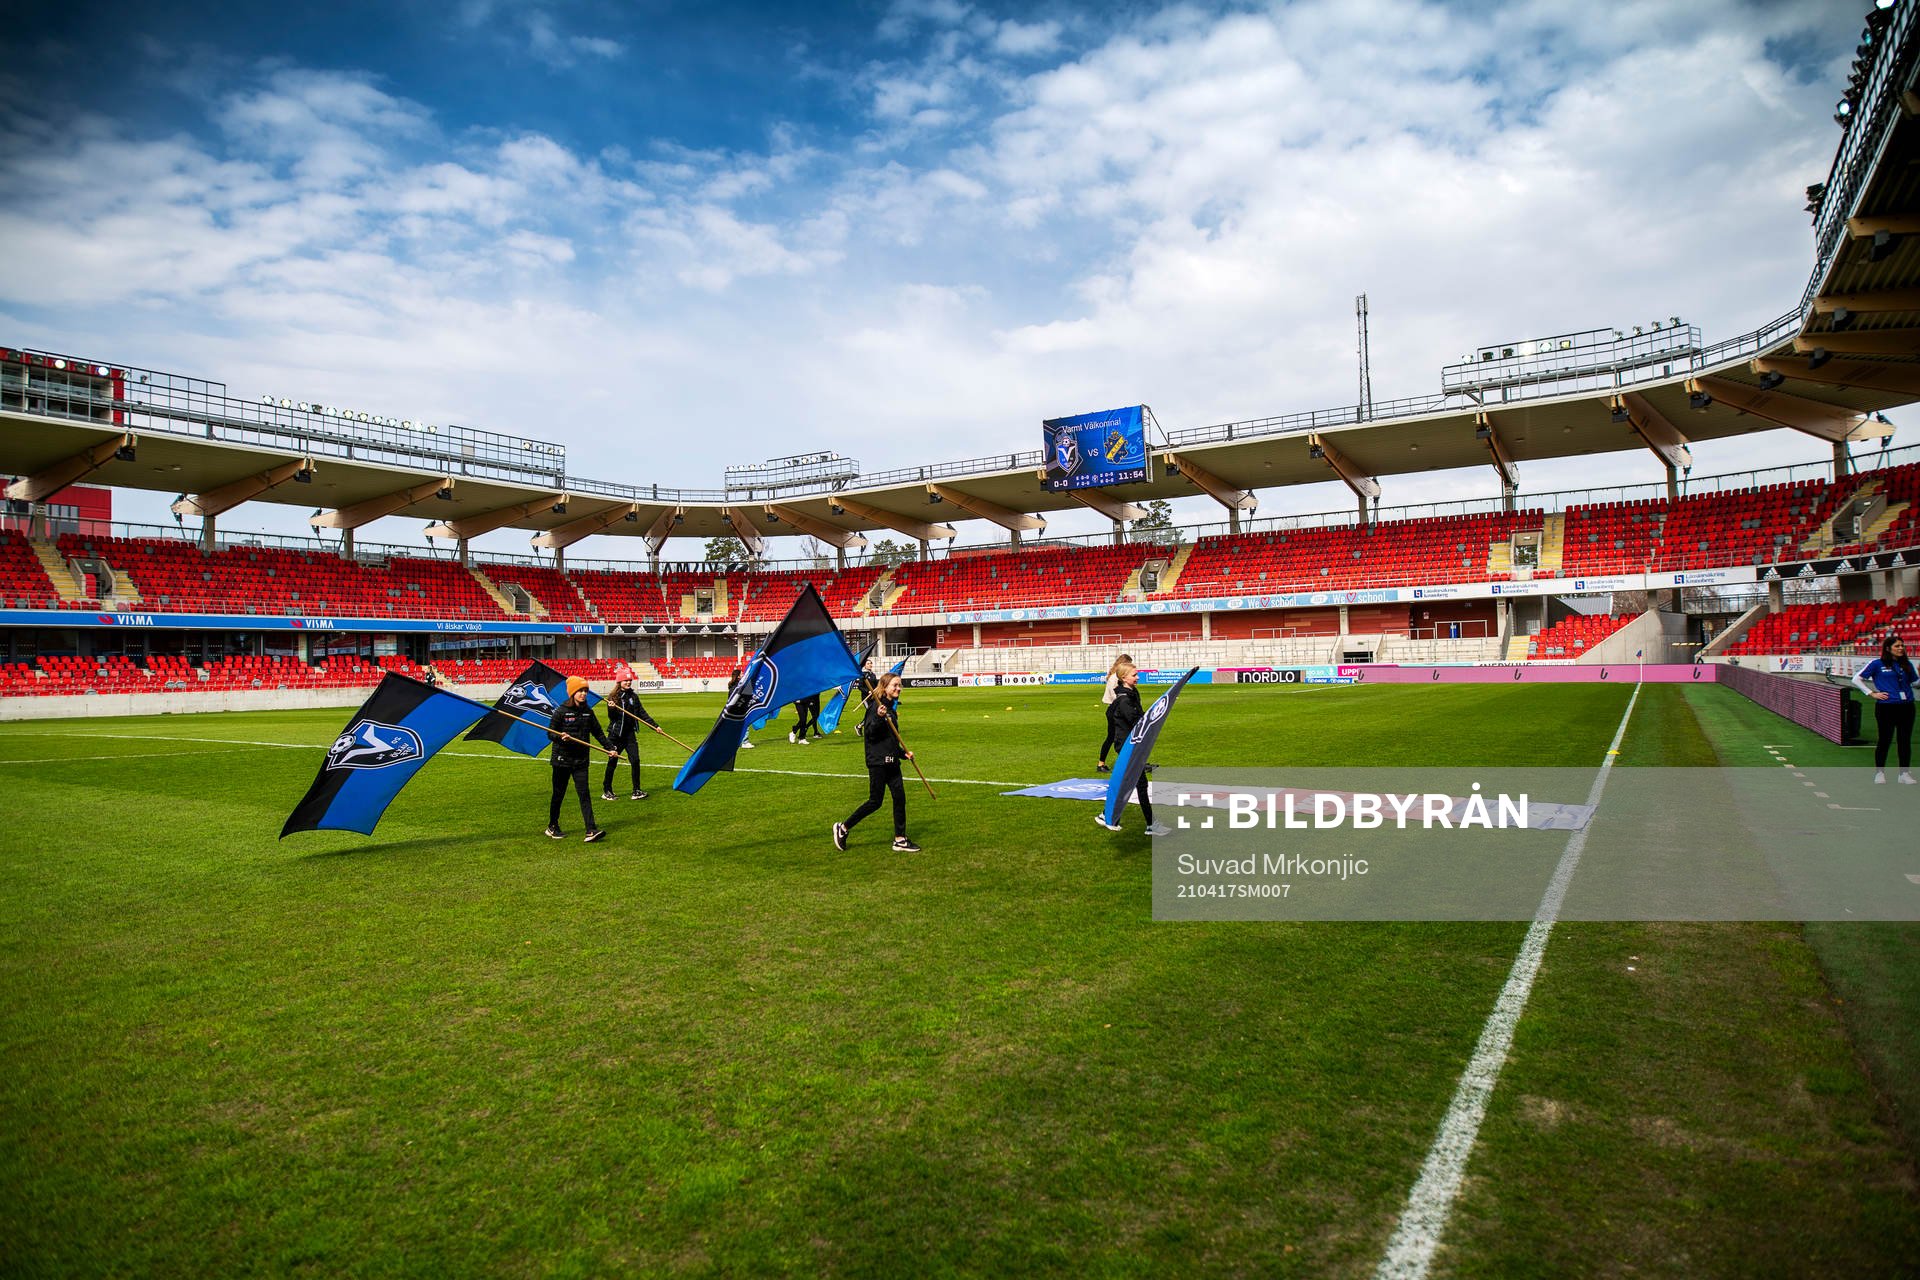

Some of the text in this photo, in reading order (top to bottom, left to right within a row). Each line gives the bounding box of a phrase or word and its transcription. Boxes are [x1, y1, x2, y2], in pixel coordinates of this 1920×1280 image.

[117, 615, 153, 626] VISMA
[306, 619, 334, 629] VISMA
[574, 625, 593, 633] VISMA
